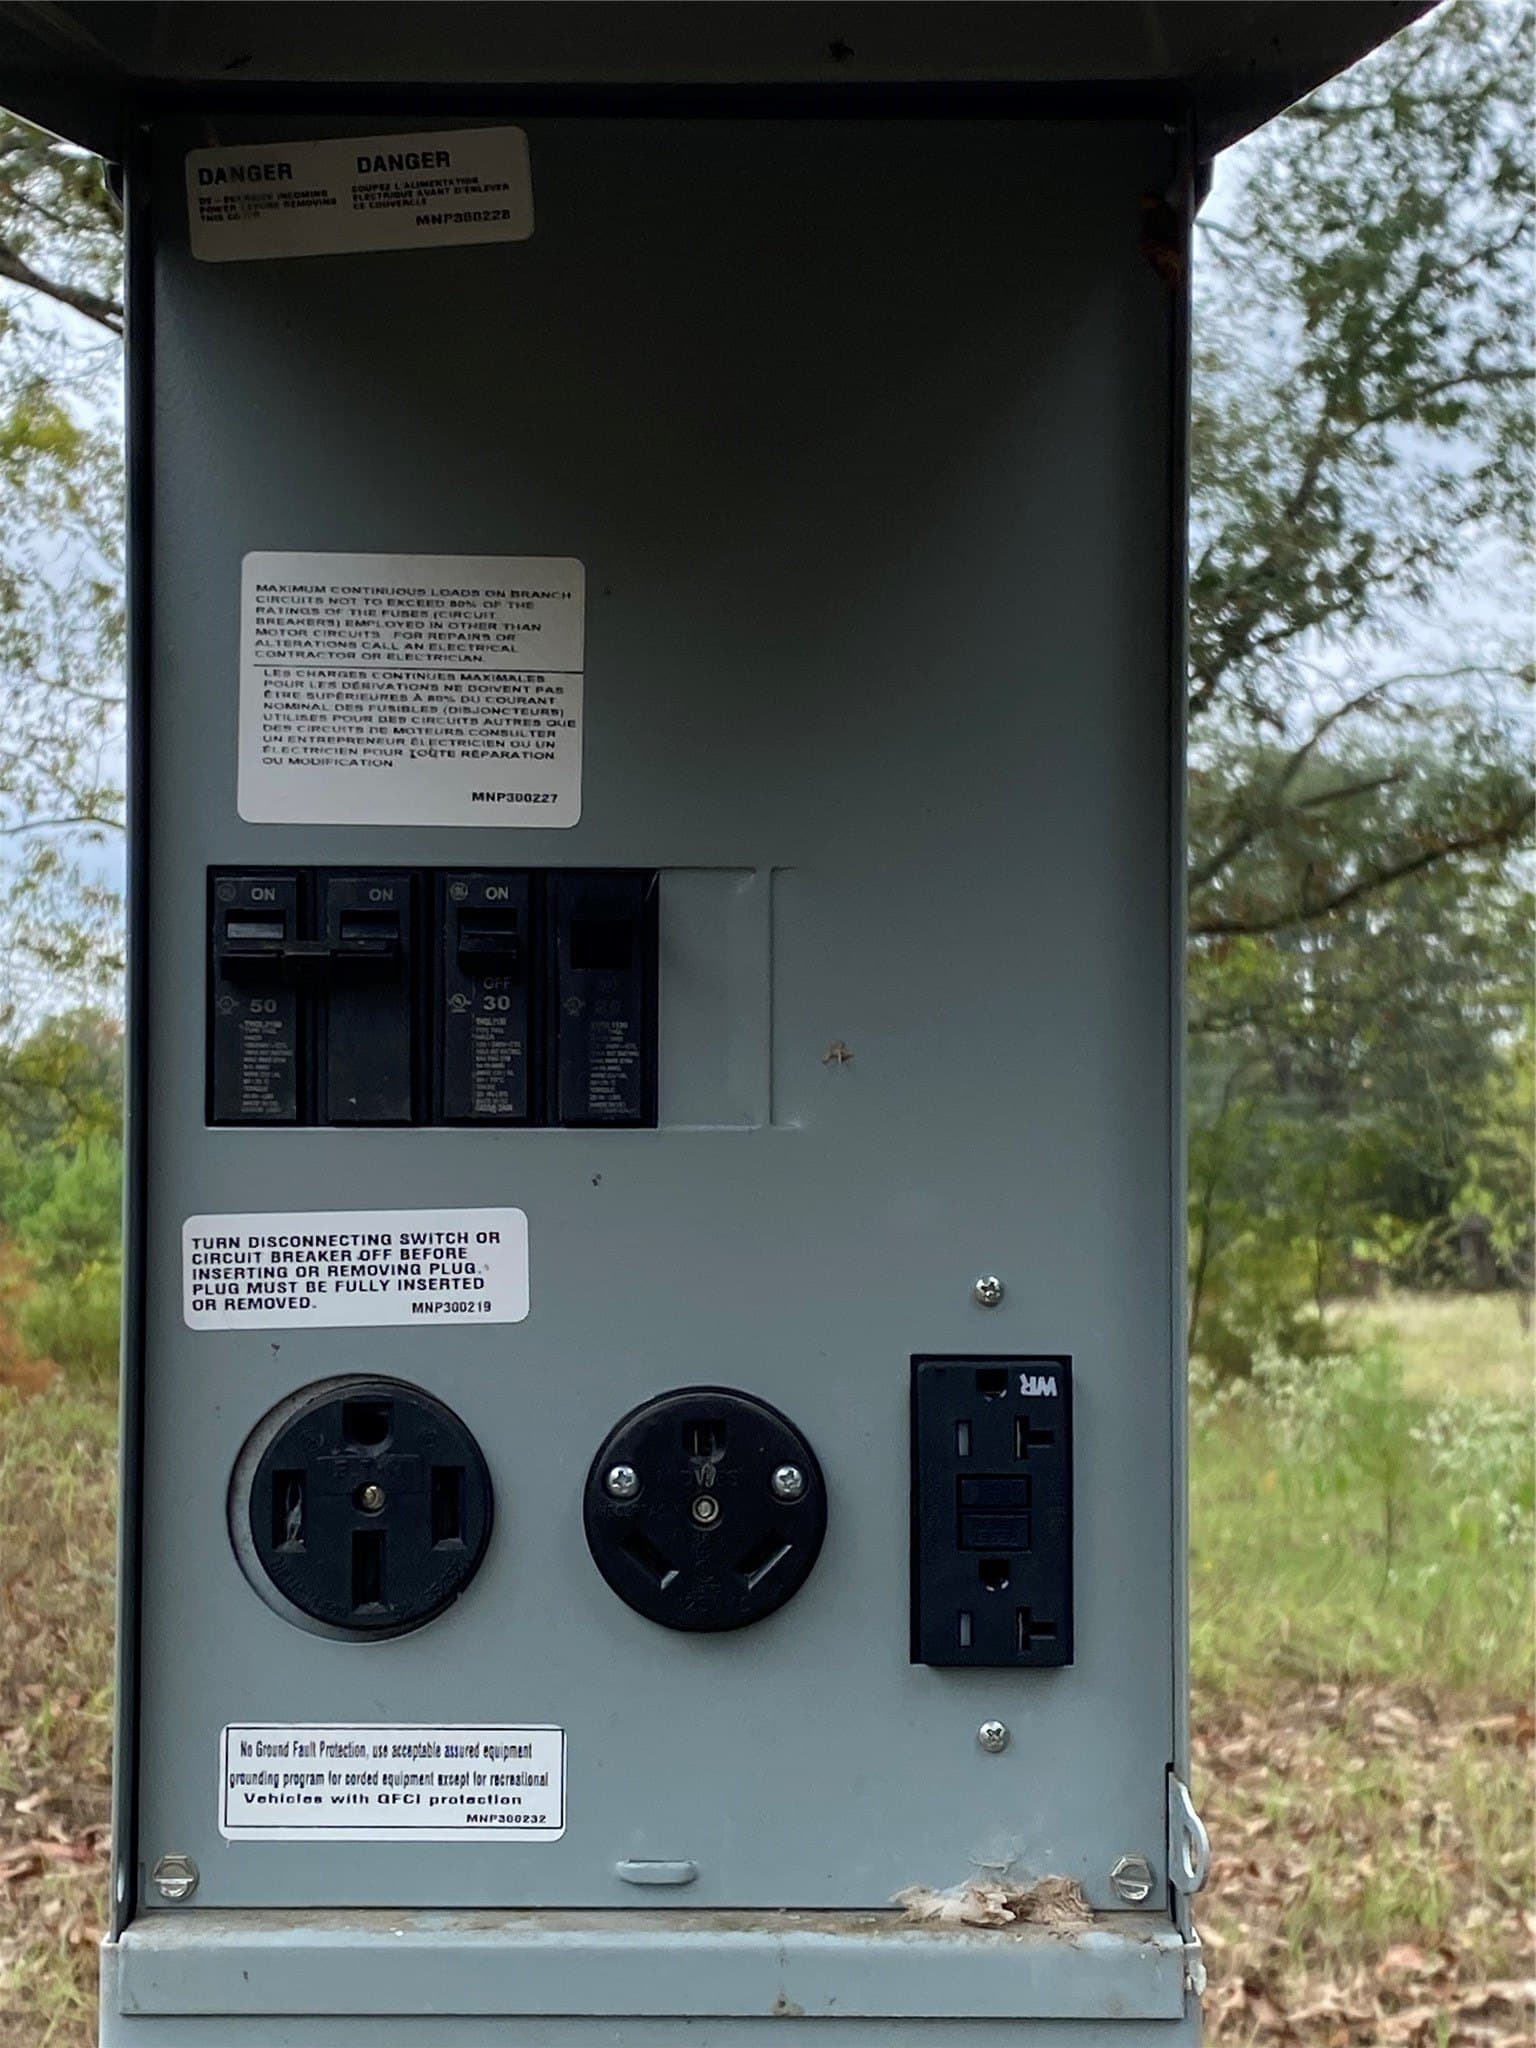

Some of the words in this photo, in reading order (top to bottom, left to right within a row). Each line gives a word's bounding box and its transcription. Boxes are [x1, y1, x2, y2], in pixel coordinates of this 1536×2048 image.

[357, 151, 450, 174] DANGER
[198, 163, 292, 186] DANGER
[417, 188, 450, 196] AVANT
[283, 198, 336, 208] REMOVING
[256, 585, 326, 593] MAXIMUM
[331, 587, 426, 596] CONTINUOUS
[432, 589, 480, 597] LOADS
[511, 590, 571, 599] BRANCH
[256, 596, 324, 604] CIRCUITS
[364, 598, 382, 606] TO
[388, 599, 444, 608] EXCEED
[450, 600, 476, 608] 80%
[483, 600, 501, 608] OF
[256, 607, 320, 615] RATINGS
[382, 610, 428, 618] FUSES
[434, 611, 494, 619] (CIRCUIT
[256, 618, 340, 628] BREAKERS)
[346, 620, 424, 629] EMPLOYED
[448, 622, 497, 630] OTHER
[256, 628, 307, 636] MOTOR
[314, 630, 380, 638] CIRCUITS
[394, 632, 422, 640] FOR
[428, 632, 490, 640] REPAIRS
[256, 640, 356, 648] ALTERATIONS
[362, 642, 398, 650] CALL
[429, 644, 516, 652] ELECTRICAL
[296, 670, 366, 678] CHARGES
[372, 672, 455, 680] CONTINUES
[461, 674, 544, 682] MAXIMALES
[264, 680, 304, 690] POUR
[342, 682, 438, 691] DÉRIVATIONS
[444, 684, 462, 692] NE
[468, 685, 530, 693] DOIVENT
[536, 686, 563, 694] PAS
[264, 702, 326, 710] NOMINAL
[335, 704, 363, 712] DES
[369, 705, 438, 713] FUSIBLES
[444, 707, 564, 718] (DISJONCTEURS)
[411, 717, 478, 725] CIRCUITS
[484, 718, 541, 726] AUTRES
[547, 720, 576, 728] QUE
[393, 728, 464, 736] MOTEURS
[469, 729, 555, 738] CONSULTER
[288, 736, 405, 744] ENTREPRENEUR
[411, 738, 504, 748] ÉLECTRICIEN
[263, 745, 358, 754] ÉLECTRICIEN
[363, 748, 403, 756] POUR
[461, 750, 554, 760] RÉPARATION
[262, 757, 282, 765] OU
[289, 758, 392, 767] MODIFICATION
[472, 792, 558, 803] MNP300227
[251, 888, 275, 900] ON
[369, 889, 393, 901] ON
[486, 887, 508, 900] ON
[484, 977, 511, 989] OFF
[250, 999, 277, 1013] 50
[483, 996, 511, 1010] 30
[192, 1237, 240, 1249] TURN
[249, 1234, 392, 1248] DISCONNECTING
[400, 1232, 468, 1244] SWITCH
[476, 1232, 500, 1244] OR
[192, 1252, 261, 1264] CIRCUIT
[272, 1250, 351, 1263] BREAKER
[361, 1249, 392, 1261] OFF
[400, 1248, 466, 1260] BEFORE
[193, 1267, 287, 1280] INSERTING
[296, 1266, 319, 1277] OR
[328, 1264, 420, 1276] REMOVING
[193, 1283, 238, 1295] PLUG
[247, 1282, 296, 1294] MUST
[306, 1281, 326, 1292] BE
[336, 1280, 390, 1292] FULLY
[398, 1278, 484, 1290] INSERTED
[192, 1299, 216, 1311] OR
[225, 1297, 316, 1310] REMOVED.
[412, 1301, 491, 1313] MNP300219
[1020, 1373, 1058, 1397] WR
[241, 1741, 252, 1757] No
[256, 1740, 289, 1757] Ground
[293, 1741, 316, 1757] Fault
[320, 1741, 368, 1758] Protection,
[373, 1745, 388, 1758] use
[392, 1742, 440, 1761] acceptable
[445, 1743, 479, 1758] assured
[484, 1744, 532, 1762] equipment
[230, 1772, 279, 1788] grounding
[284, 1774, 324, 1788] program
[328, 1770, 342, 1785] for
[346, 1772, 378, 1785] corded
[383, 1772, 433, 1788] equipment
[438, 1772, 469, 1788] except
[474, 1771, 486, 1786] for
[490, 1772, 548, 1786] recreational
[244, 1793, 322, 1803] Vehicles
[331, 1794, 368, 1804] with
[430, 1794, 521, 1806] protection
[467, 1814, 546, 1823] MNP300232
